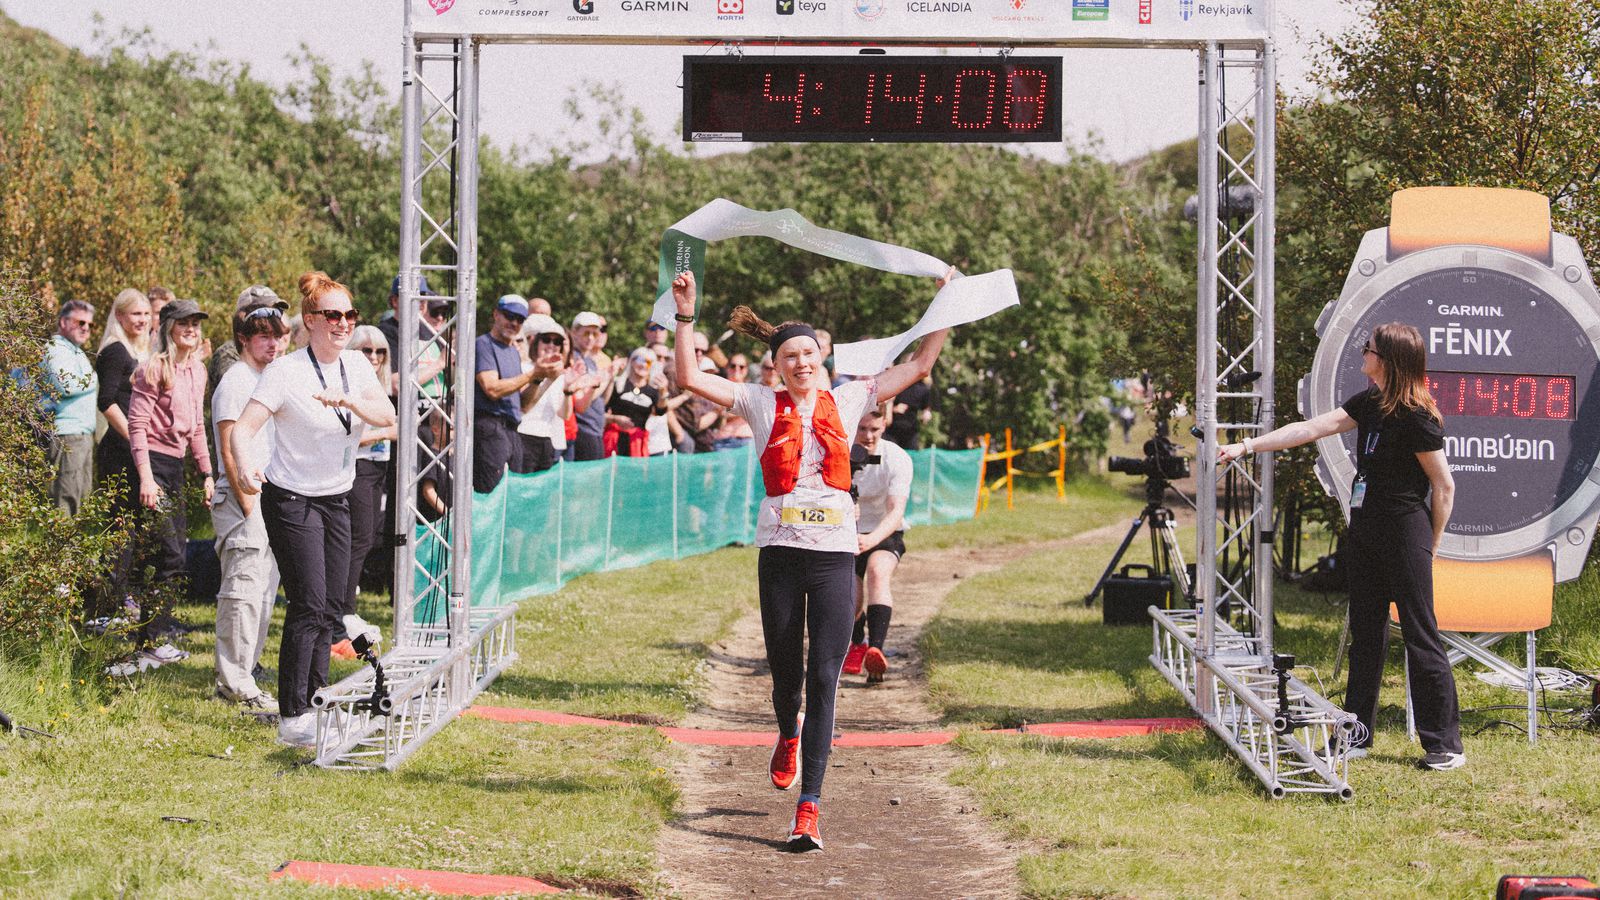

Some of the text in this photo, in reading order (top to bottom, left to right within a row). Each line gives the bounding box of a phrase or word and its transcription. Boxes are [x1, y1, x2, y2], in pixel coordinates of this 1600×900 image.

[621, 1, 689, 11] GARMIN
[799, 1, 826, 13] teya
[907, 2, 972, 13] ICELANDIA
[479, 9, 549, 17] COMPRESSPORT
[1429, 322, 1513, 356] FĒNIX
[800, 509, 825, 522] 128
[1449, 522, 1493, 533] GARMIN
